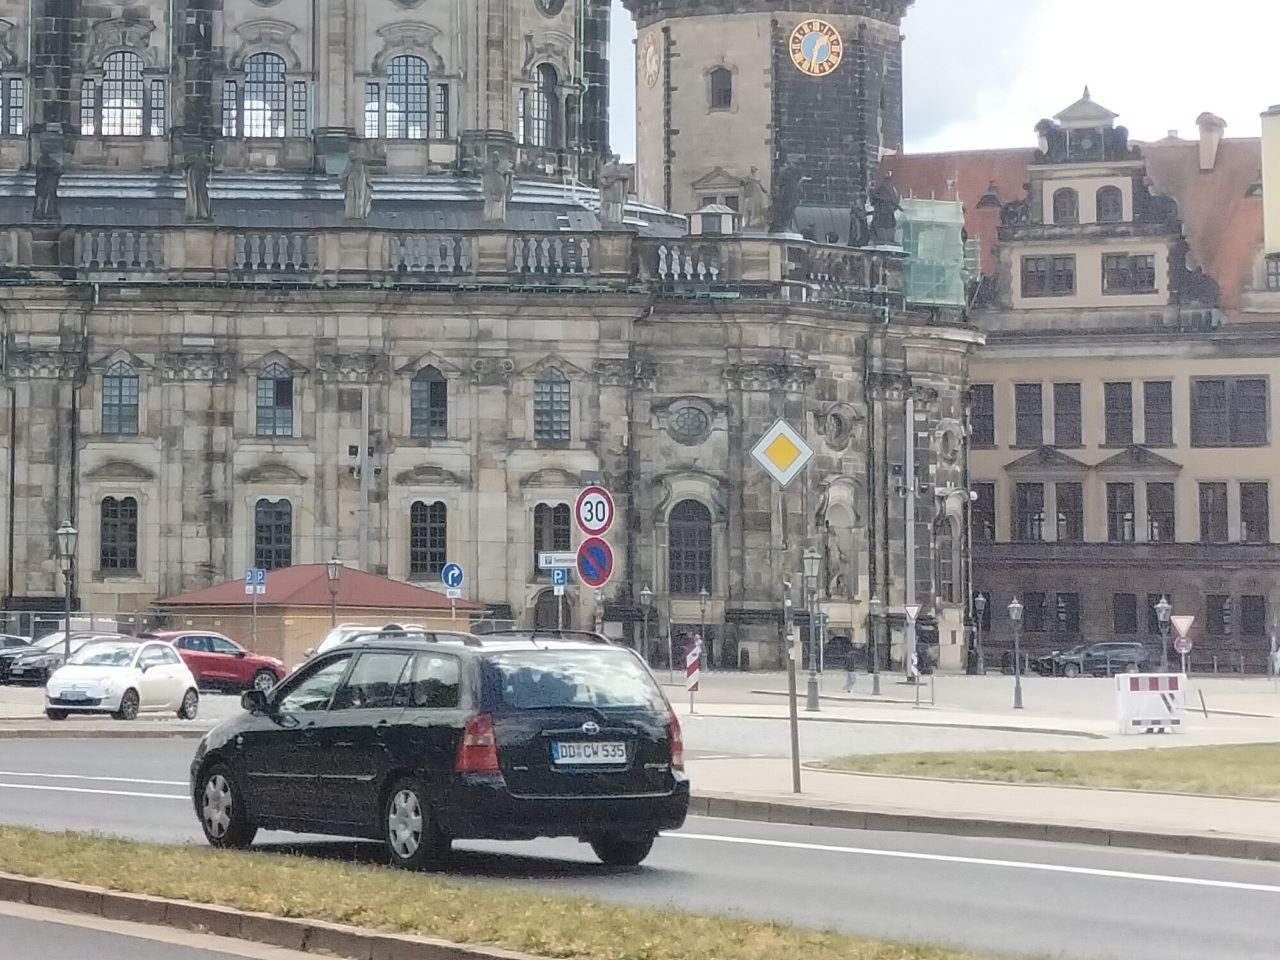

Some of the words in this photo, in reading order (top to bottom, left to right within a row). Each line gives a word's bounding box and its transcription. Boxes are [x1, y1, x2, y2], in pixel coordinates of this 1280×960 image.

[583, 500, 606, 522] 30
[560, 745, 576, 759] DD
[601, 744, 625, 758] 535
